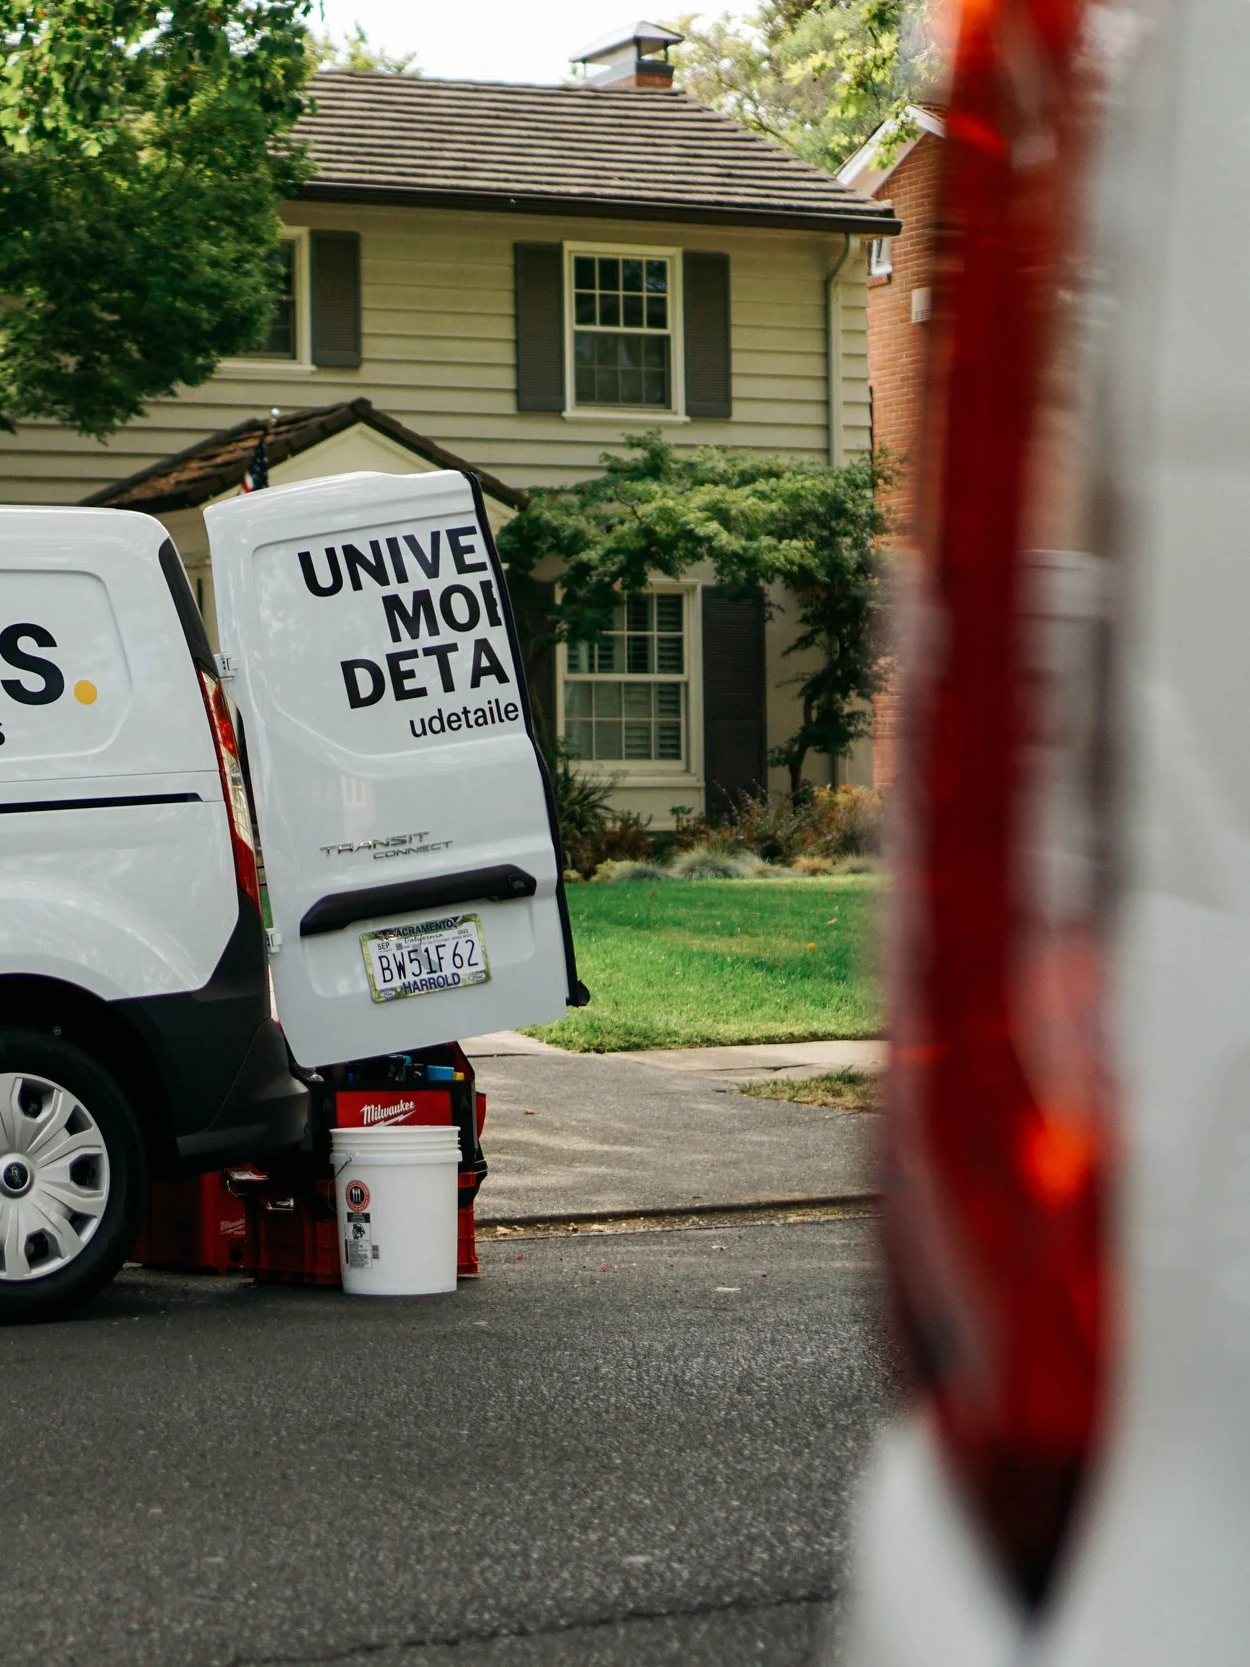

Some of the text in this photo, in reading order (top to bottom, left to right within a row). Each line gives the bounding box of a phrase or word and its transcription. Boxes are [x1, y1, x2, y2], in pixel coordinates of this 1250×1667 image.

[298, 526, 488, 597] UNIVE
[340, 638, 510, 709] DETA
[409, 698, 519, 738] udetaile
[319, 831, 430, 857] TRANSIT
[373, 840, 453, 860] CONNECT
[388, 919, 454, 939] SACRAMENTO
[404, 933, 443, 946] California
[376, 942, 390, 951] SEP
[378, 939, 479, 983] BW51F62
[402, 972, 461, 995] HARROLD
[360, 1099, 415, 1125] Milwaukee
